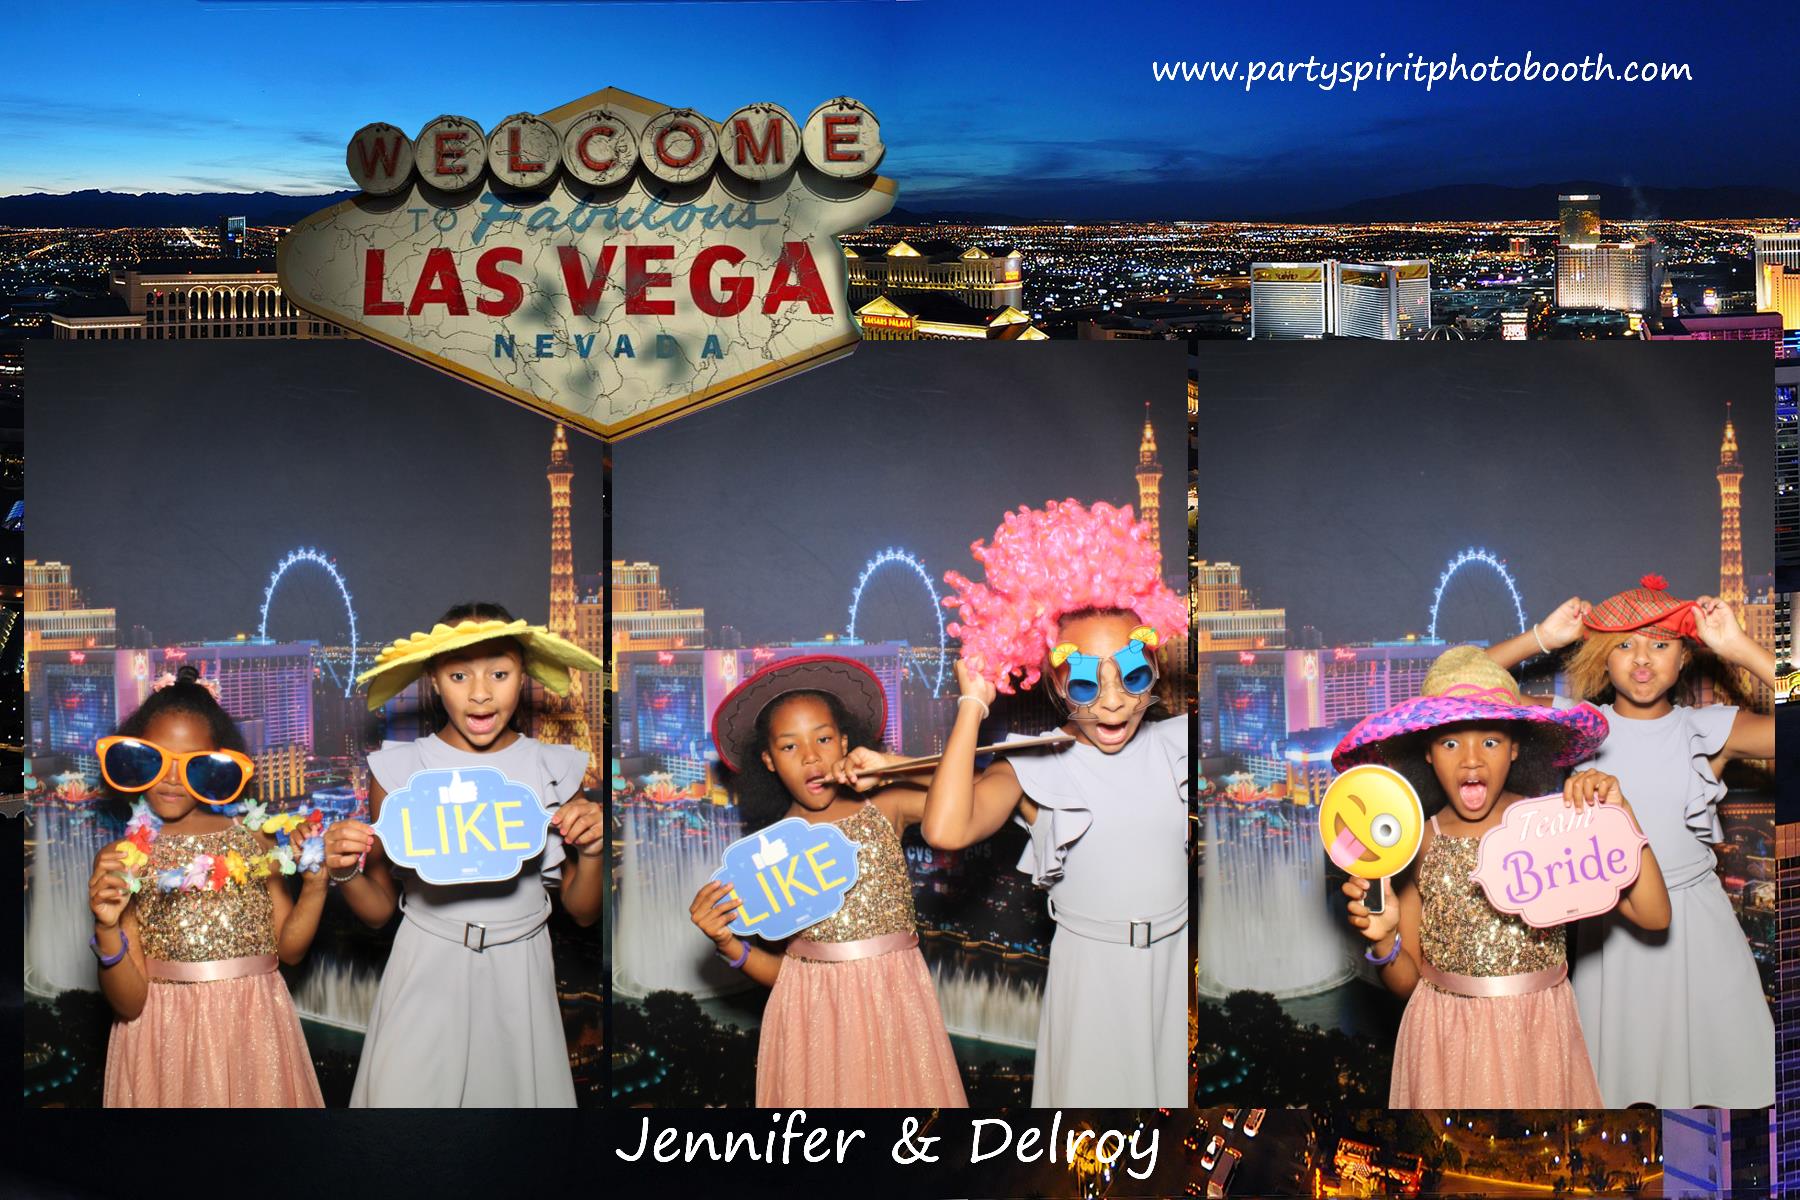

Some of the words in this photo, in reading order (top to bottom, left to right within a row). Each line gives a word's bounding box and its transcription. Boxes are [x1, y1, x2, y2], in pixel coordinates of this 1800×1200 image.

[355, 114, 865, 179] WELCOME
[407, 208, 459, 234] TO
[471, 188, 780, 245] Fabulous
[362, 245, 526, 317] LAS
[494, 333, 726, 360] NEVADA
[401, 801, 531, 857] LIKE
[1519, 809, 1595, 842] Team
[907, 847, 933, 863] CVS
[1502, 834, 1628, 904] Bride
[729, 841, 848, 928] LIKE
